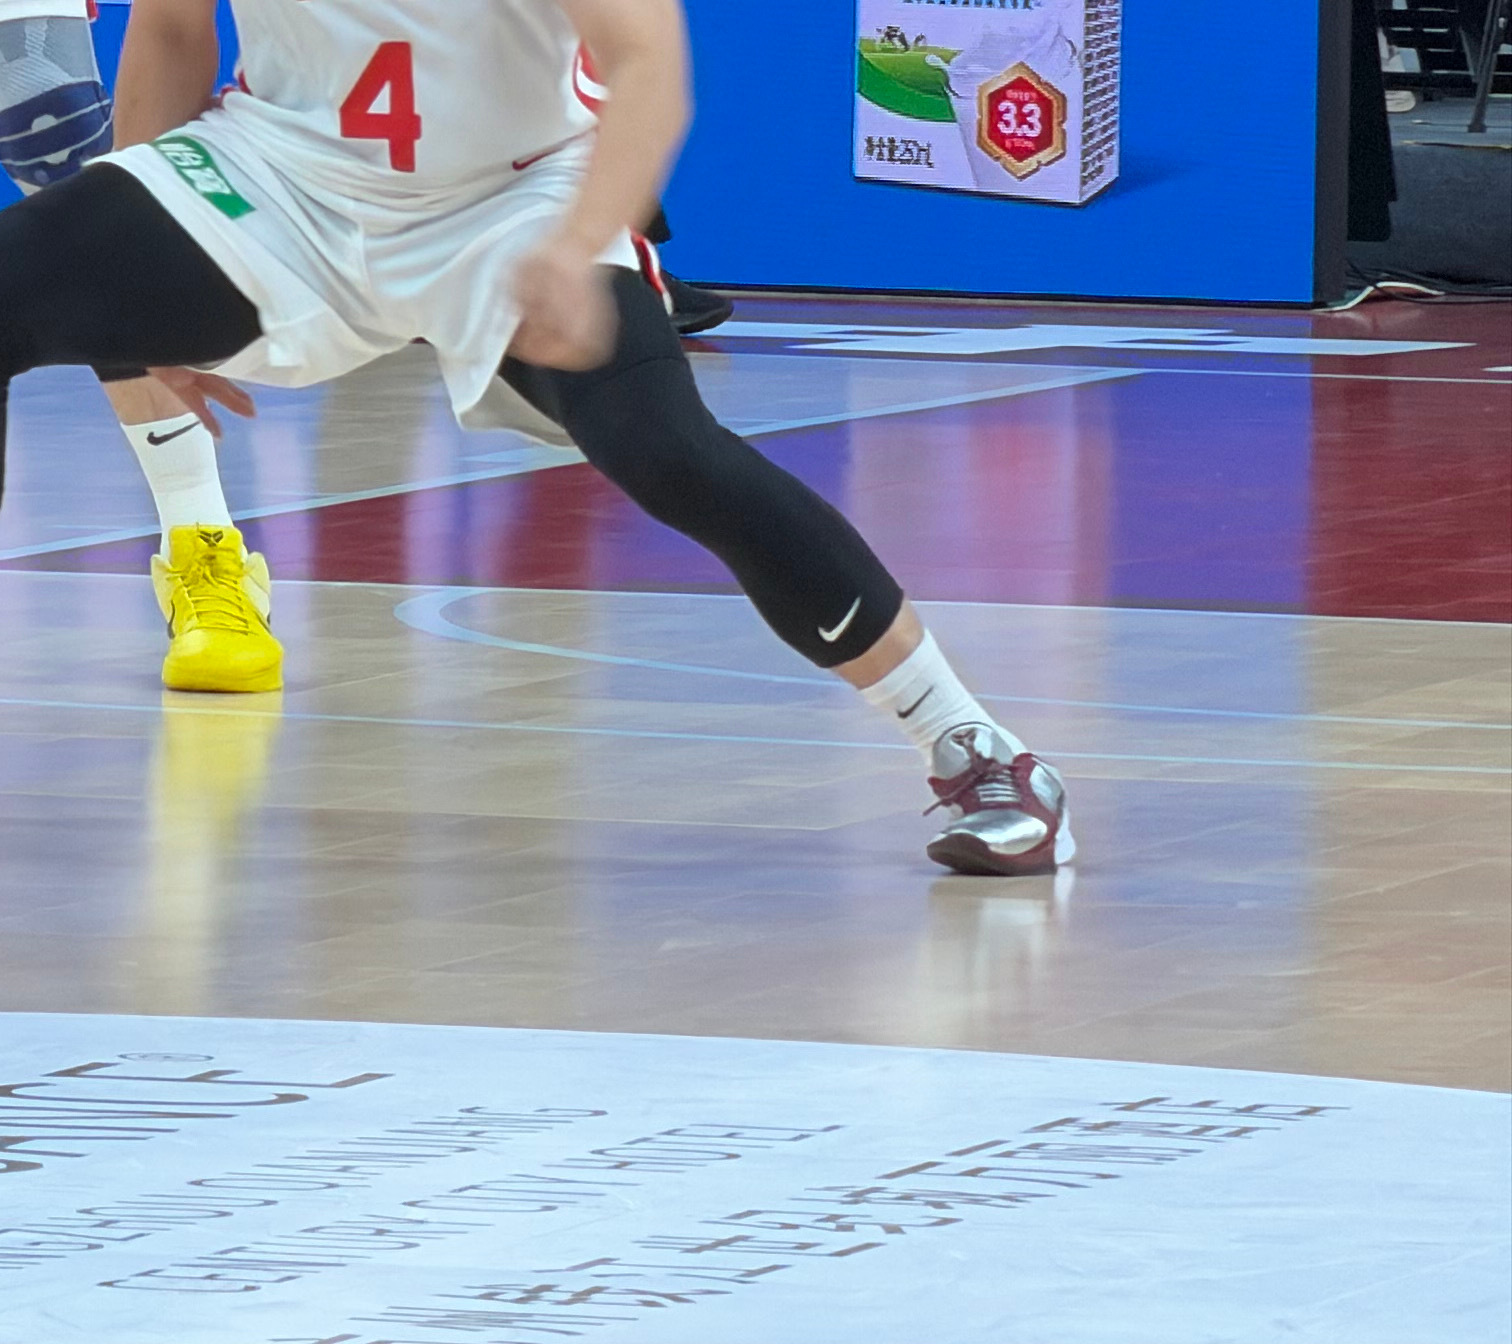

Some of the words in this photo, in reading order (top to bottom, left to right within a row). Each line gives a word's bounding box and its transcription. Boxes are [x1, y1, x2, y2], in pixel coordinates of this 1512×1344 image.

[339, 41, 422, 174] 4
[97, 1213, 494, 1294] CENTURY
[402, 1173, 641, 1214] CITY
[543, 1123, 846, 1174] HOTEL
[187, 1105, 608, 1192] QIANJIANG
